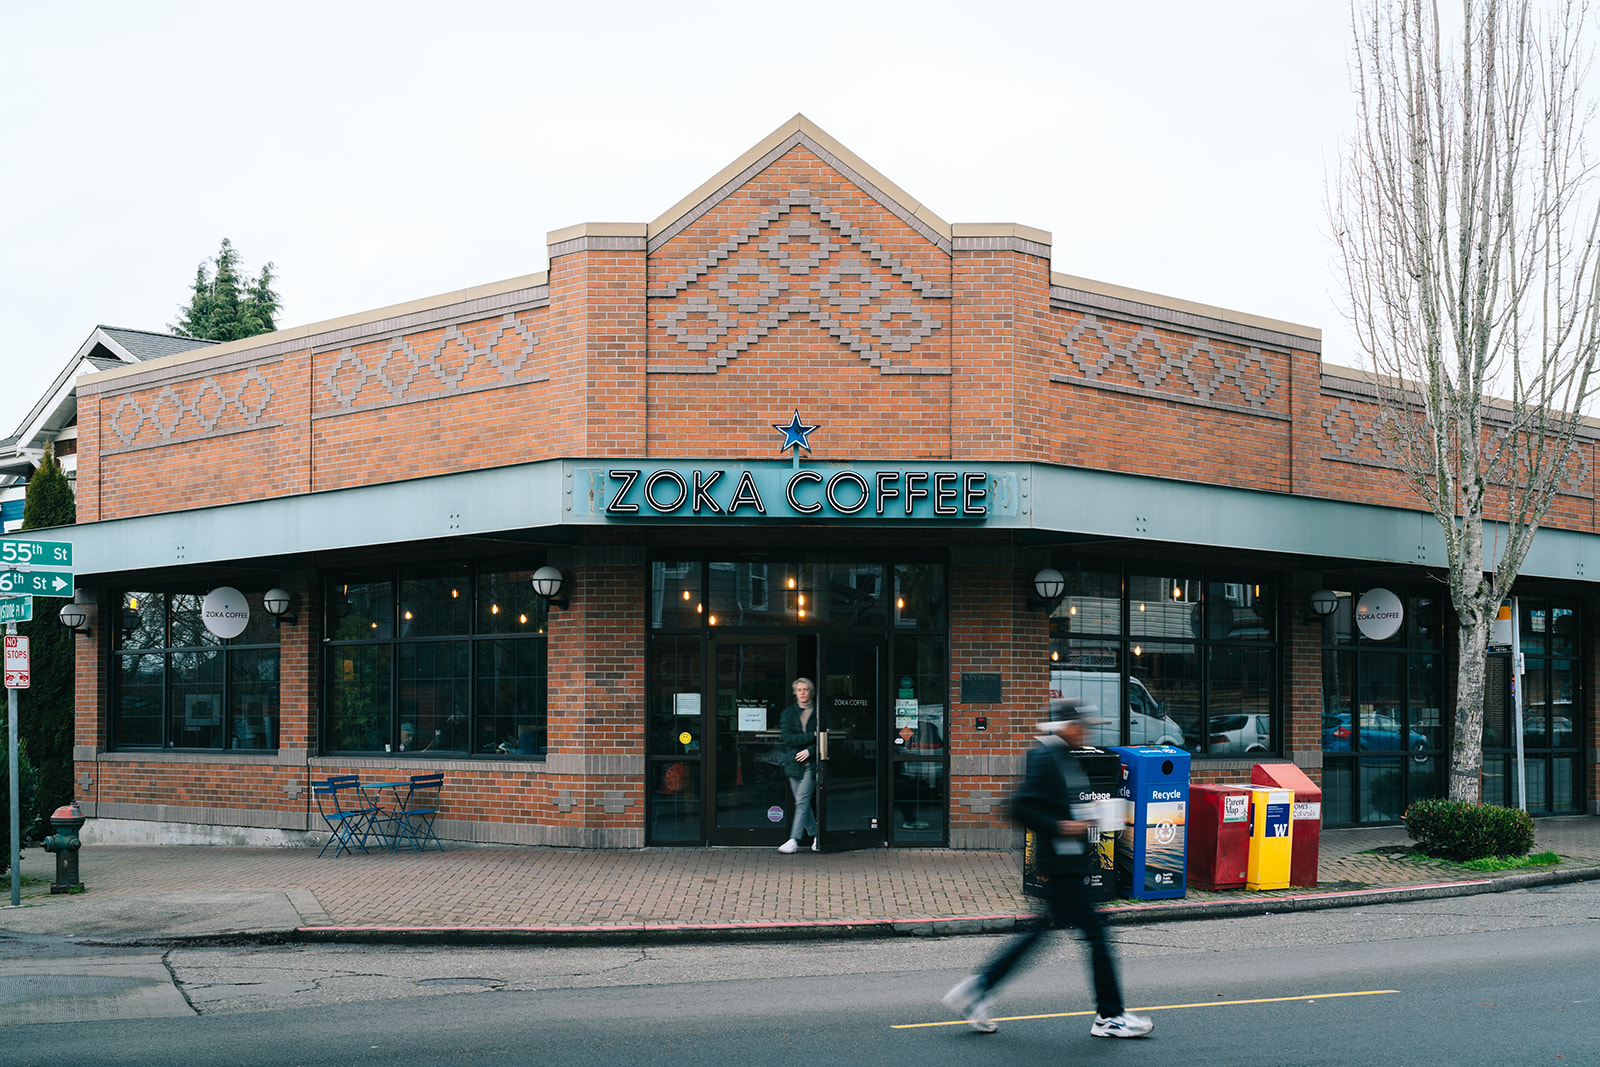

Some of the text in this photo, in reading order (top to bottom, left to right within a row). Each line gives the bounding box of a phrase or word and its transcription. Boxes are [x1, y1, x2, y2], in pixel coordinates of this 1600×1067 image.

[606, 469, 988, 515] ZOKA COFFEE
[2, 542, 68, 561] 55th St
[33, 576, 47, 590] St
[6, 637, 16, 647] NO
[7, 650, 27, 659] STOPS
[1152, 789, 1181, 801] Recycle
[1225, 797, 1245, 806] Parent
[1225, 806, 1239, 816] Map
[1273, 823, 1288, 837] W
